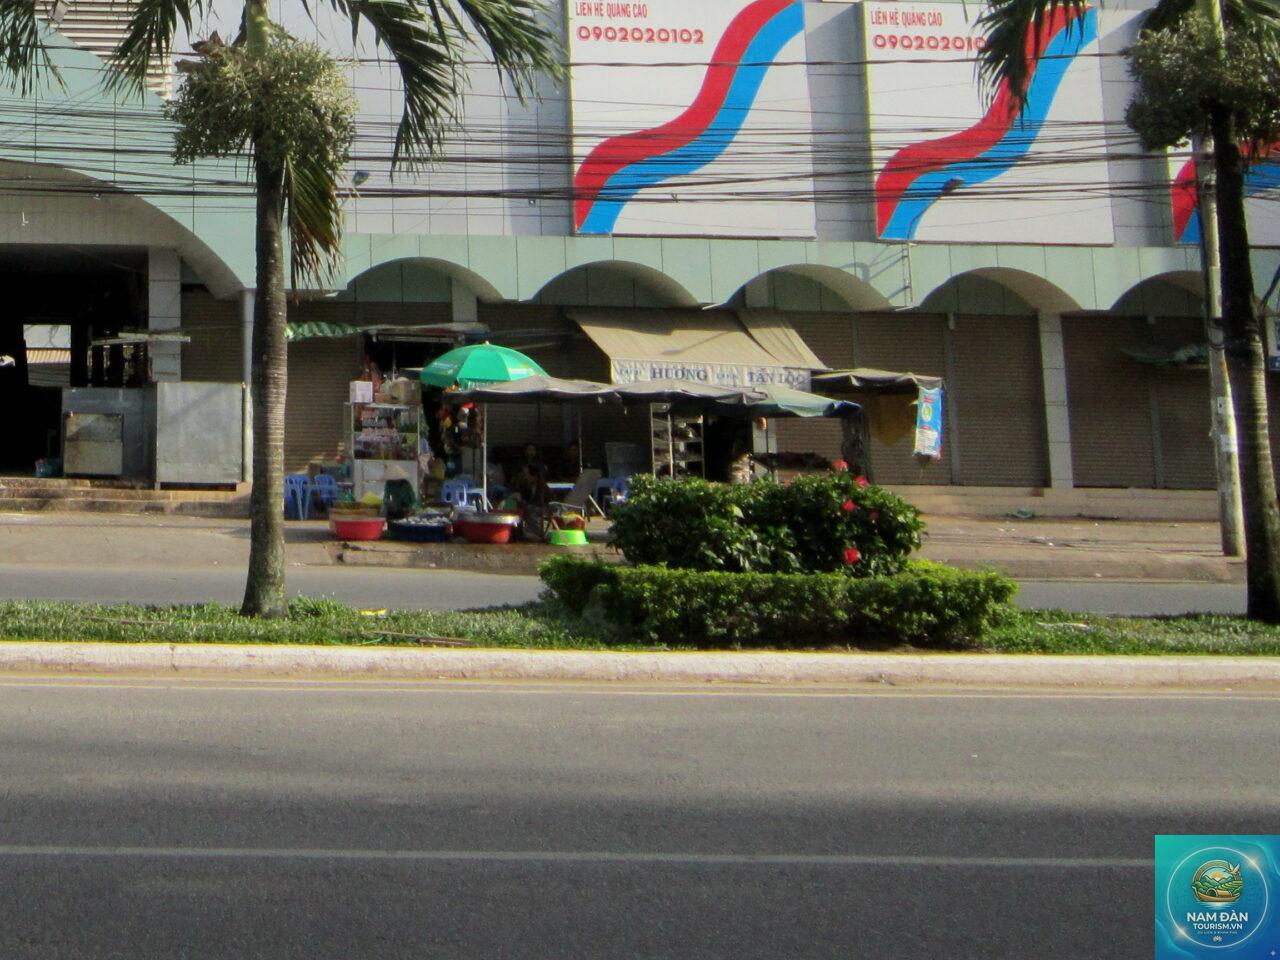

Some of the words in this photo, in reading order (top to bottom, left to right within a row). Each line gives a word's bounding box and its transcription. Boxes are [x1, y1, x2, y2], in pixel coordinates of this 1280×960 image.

[632, 0, 647, 18] CÁO
[871, 7, 888, 25] LIÊN
[889, 7, 899, 28] HỆ
[901, 6, 927, 27] QUẢNG
[927, 8, 943, 26] CÁO
[577, 25, 704, 44] 0902020102
[873, 34, 989, 52] 090202010
